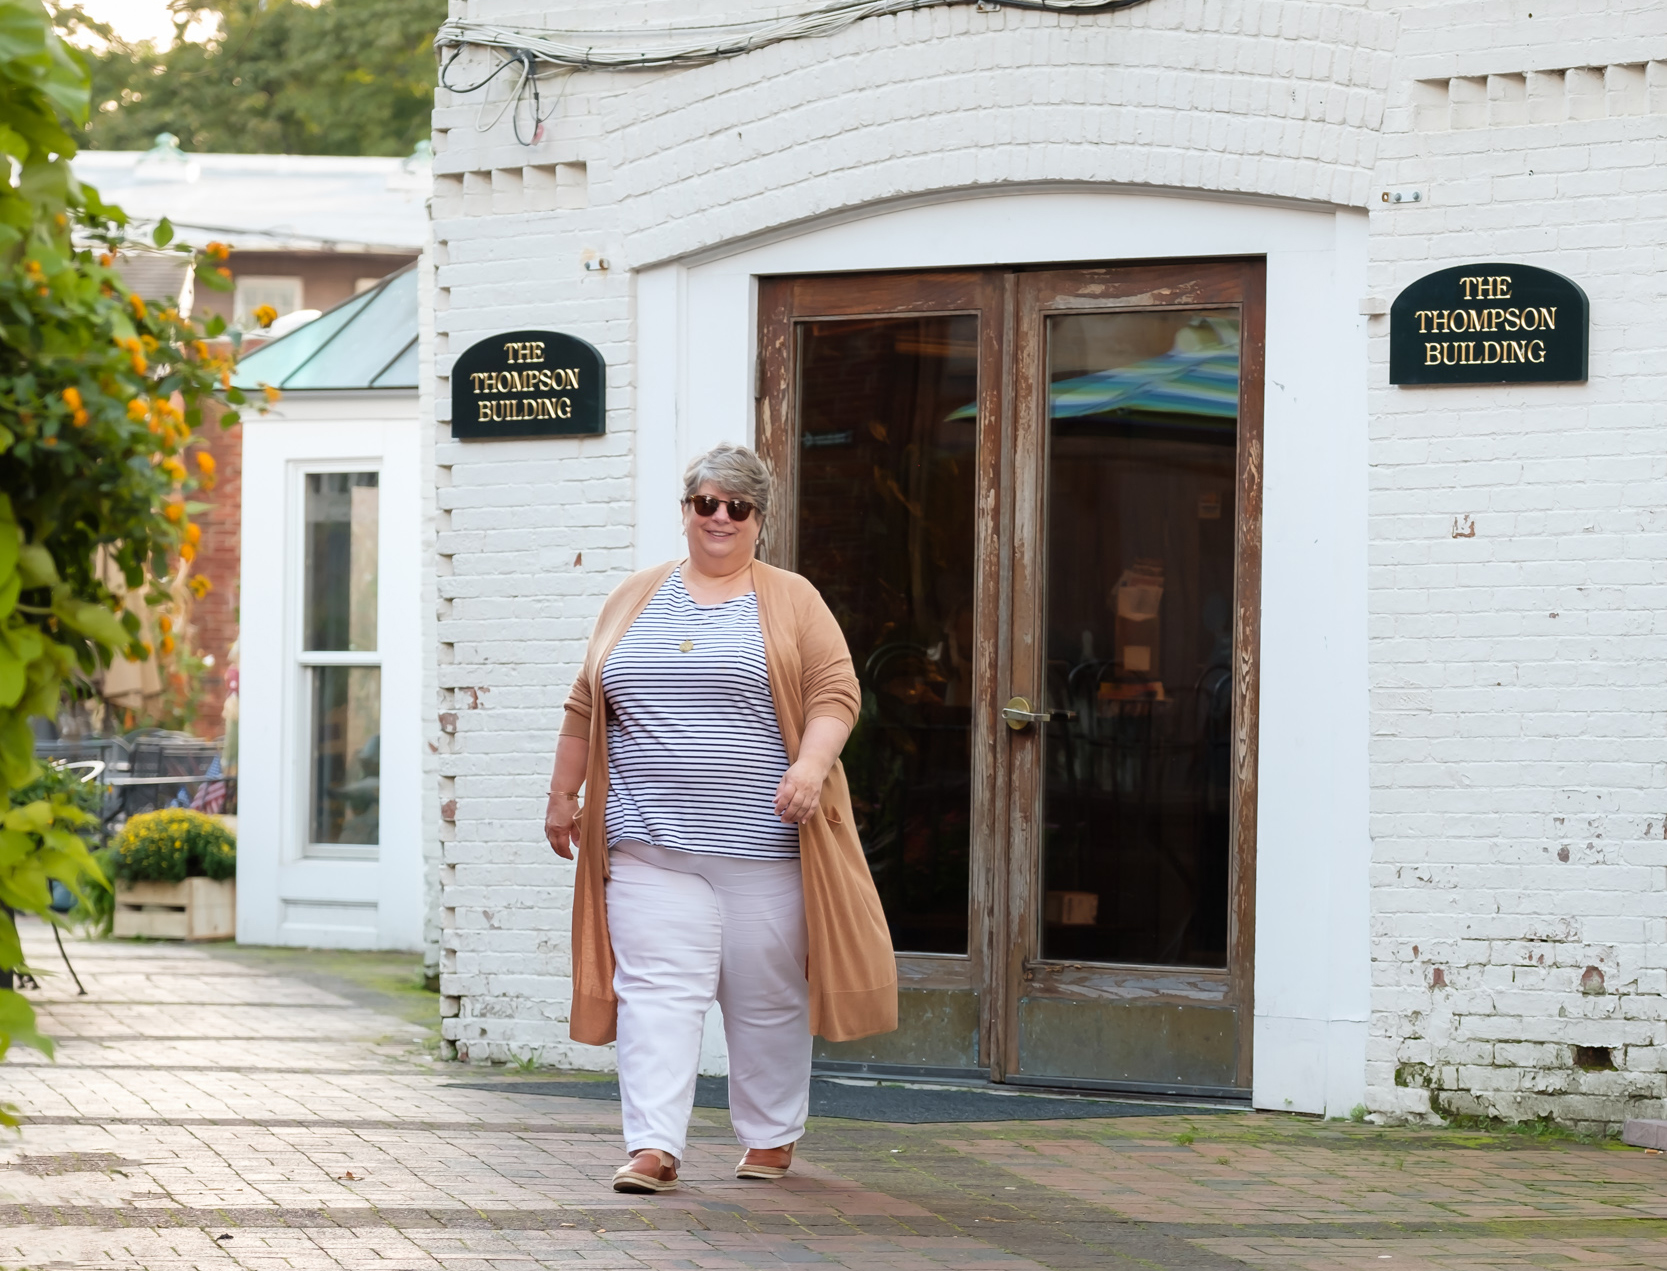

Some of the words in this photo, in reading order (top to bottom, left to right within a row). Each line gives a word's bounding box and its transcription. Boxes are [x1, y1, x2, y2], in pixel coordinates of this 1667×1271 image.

[1459, 275, 1512, 300] THE
[1414, 307, 1557, 333] THOMPSON
[504, 341, 545, 364] THE
[1424, 339, 1547, 366] BUILDING
[469, 368, 580, 394] THOMPSON
[477, 397, 572, 422] BUILDING
